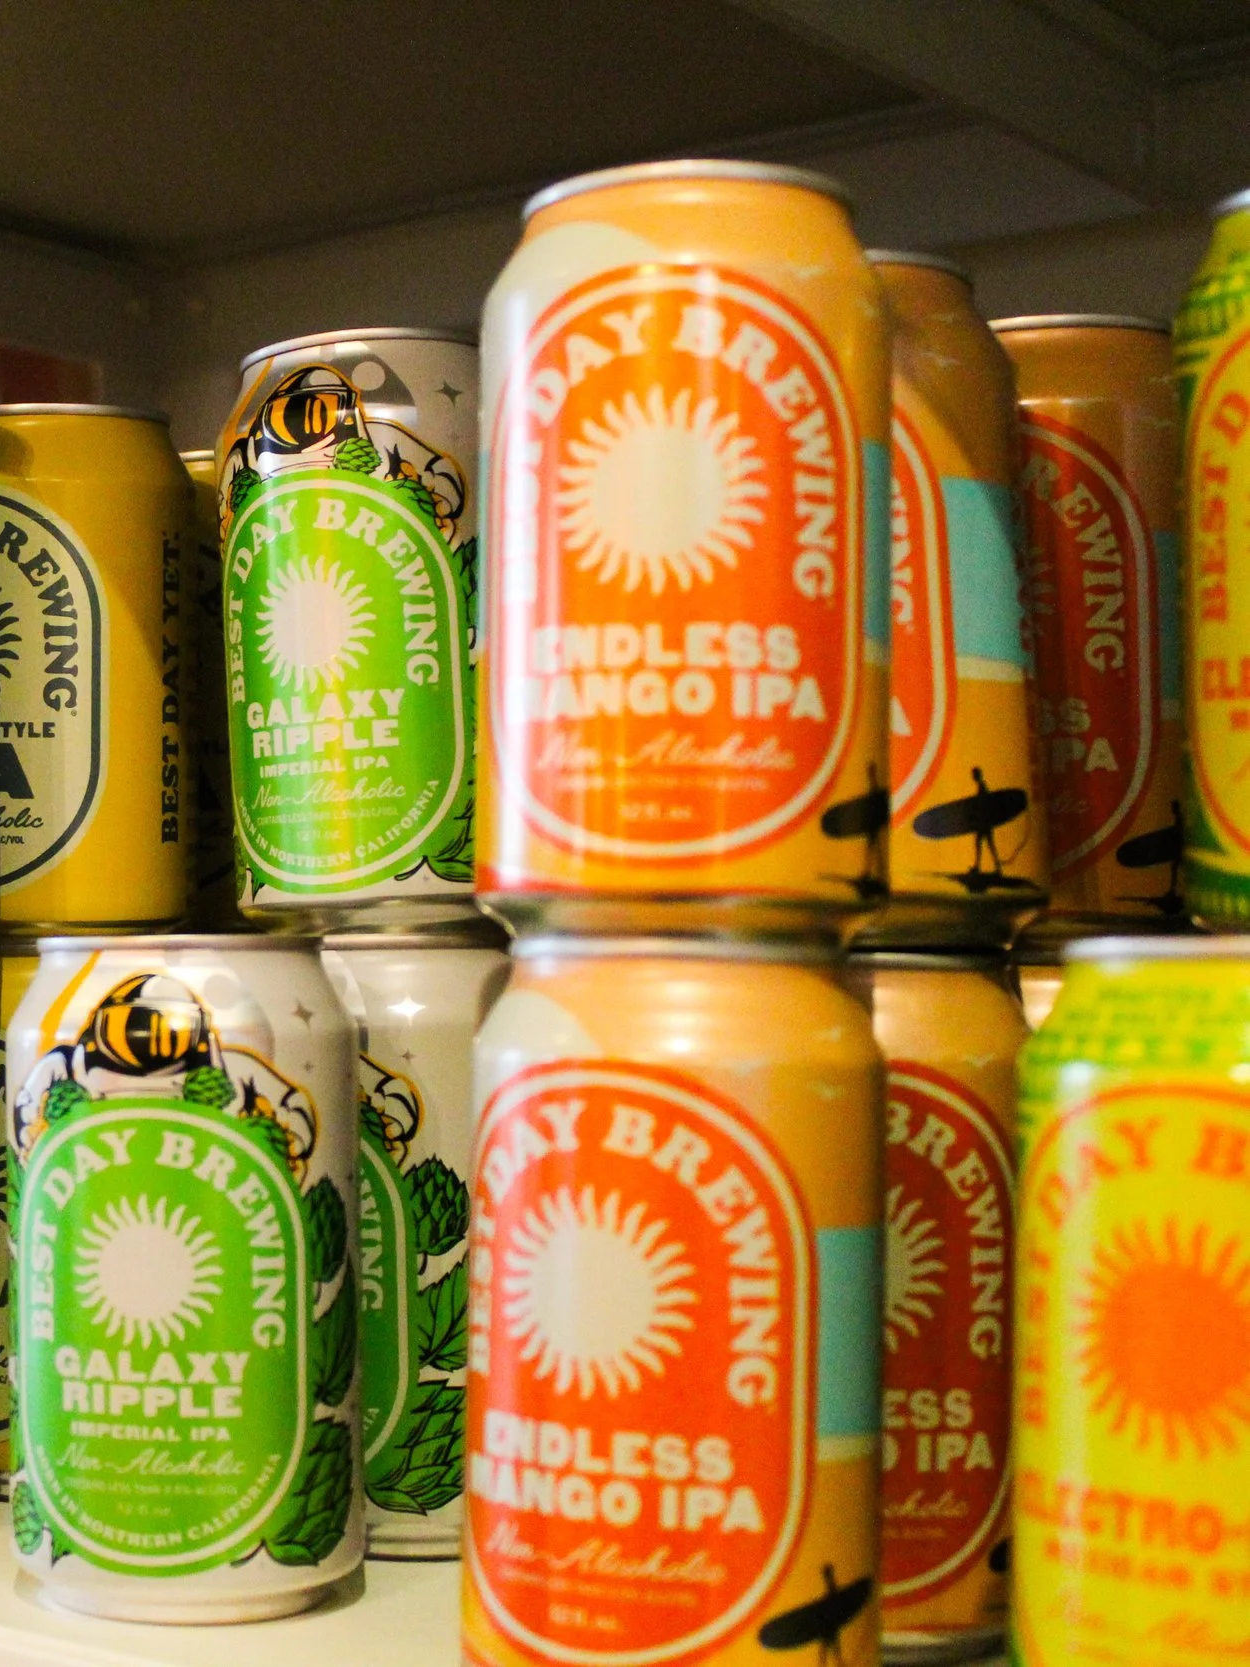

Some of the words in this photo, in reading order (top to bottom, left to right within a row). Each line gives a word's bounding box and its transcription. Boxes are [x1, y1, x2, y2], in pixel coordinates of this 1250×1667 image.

[526, 304, 656, 427] DAY
[672, 305, 838, 602] BREWING
[232, 498, 298, 584] DAY
[1022, 452, 1126, 674] REWING
[313, 497, 440, 687] BREWING
[162, 636, 182, 731] DAY
[229, 592, 246, 704] BEST
[533, 621, 802, 674] ENDLESS
[246, 688, 406, 730] GALAXY
[731, 672, 827, 723] IPA
[252, 719, 400, 759] RIPPLE
[259, 758, 347, 779] IMPERIAL
[353, 755, 390, 771] IPA
[162, 735, 181, 845] BEST
[269, 848, 351, 868] NORTHERN
[354, 779, 440, 859] CALIFORNIA
[30, 1209, 58, 1342] BEST
[44, 1128, 138, 1212] DAY
[156, 1129, 286, 1350] BREWING
[481, 1099, 591, 1196] DAY
[601, 1102, 781, 1407] BREWING
[53, 1345, 251, 1385] GALAXY
[61, 1380, 243, 1419] RIPPLE
[190, 1426, 232, 1442] IPA
[483, 1407, 736, 1484] ENDLESS
[915, 1432, 995, 1473] IPA
[658, 1484, 766, 1534] IPA
